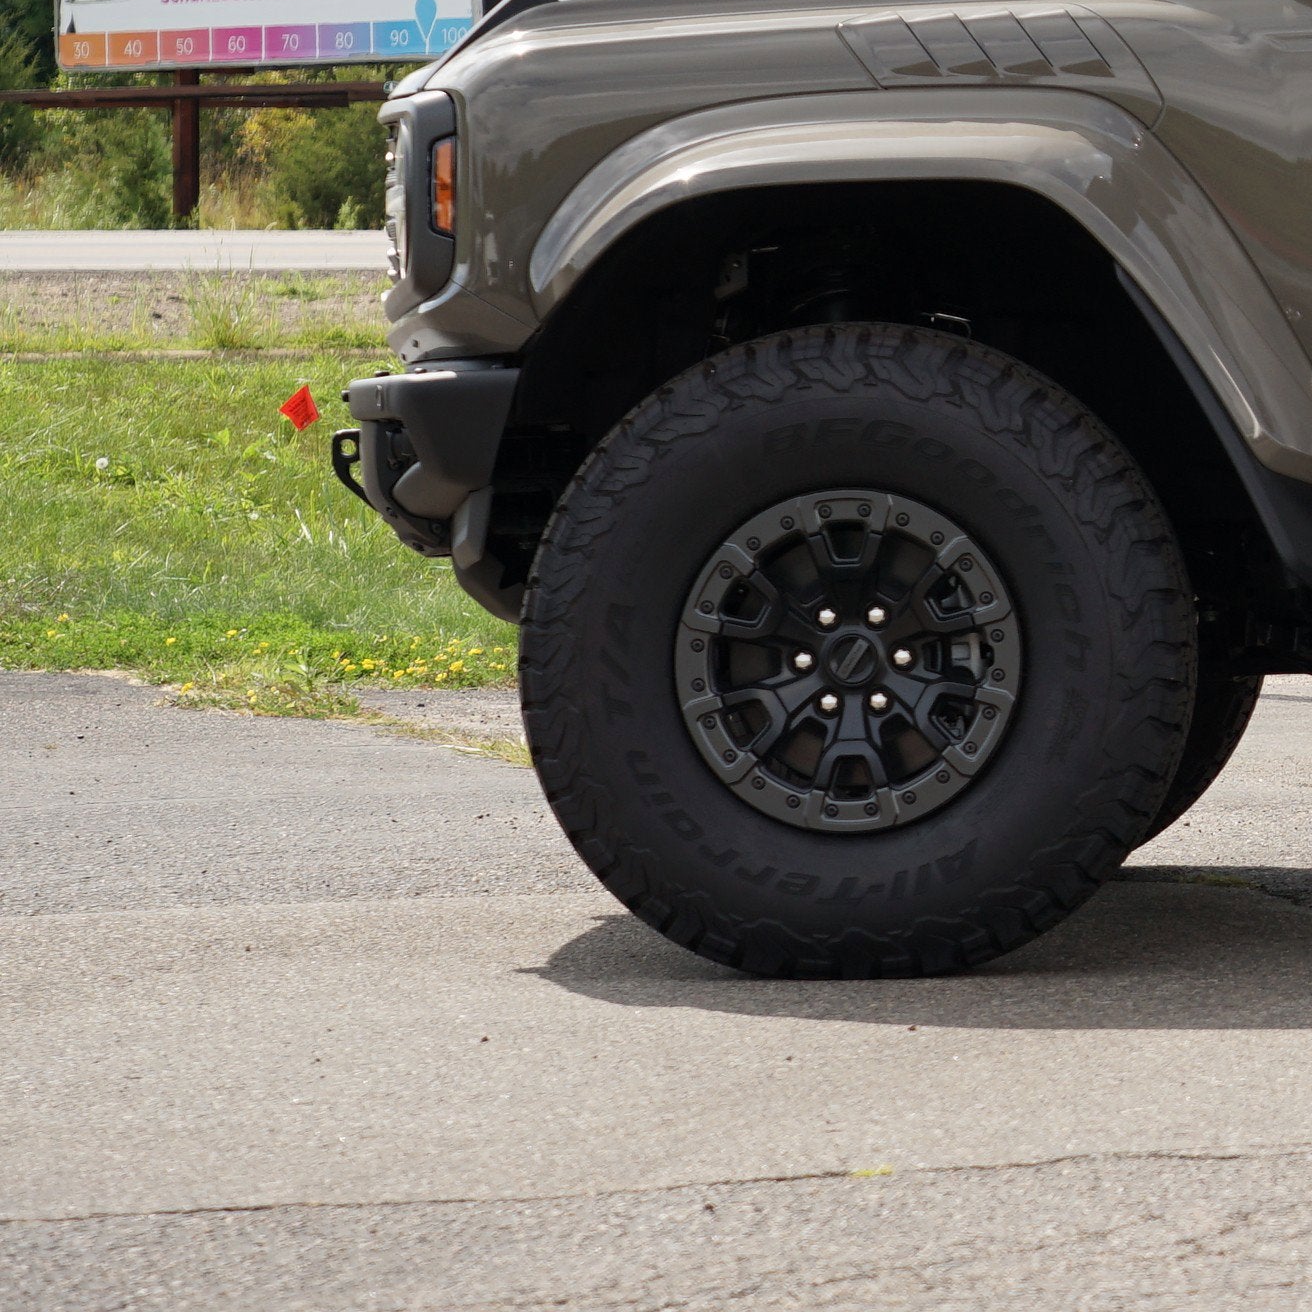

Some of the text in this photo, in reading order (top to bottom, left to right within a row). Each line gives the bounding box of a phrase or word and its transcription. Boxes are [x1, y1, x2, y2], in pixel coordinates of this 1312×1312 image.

[73, 26, 467, 59] 30 40 50 60 70 80 90 100
